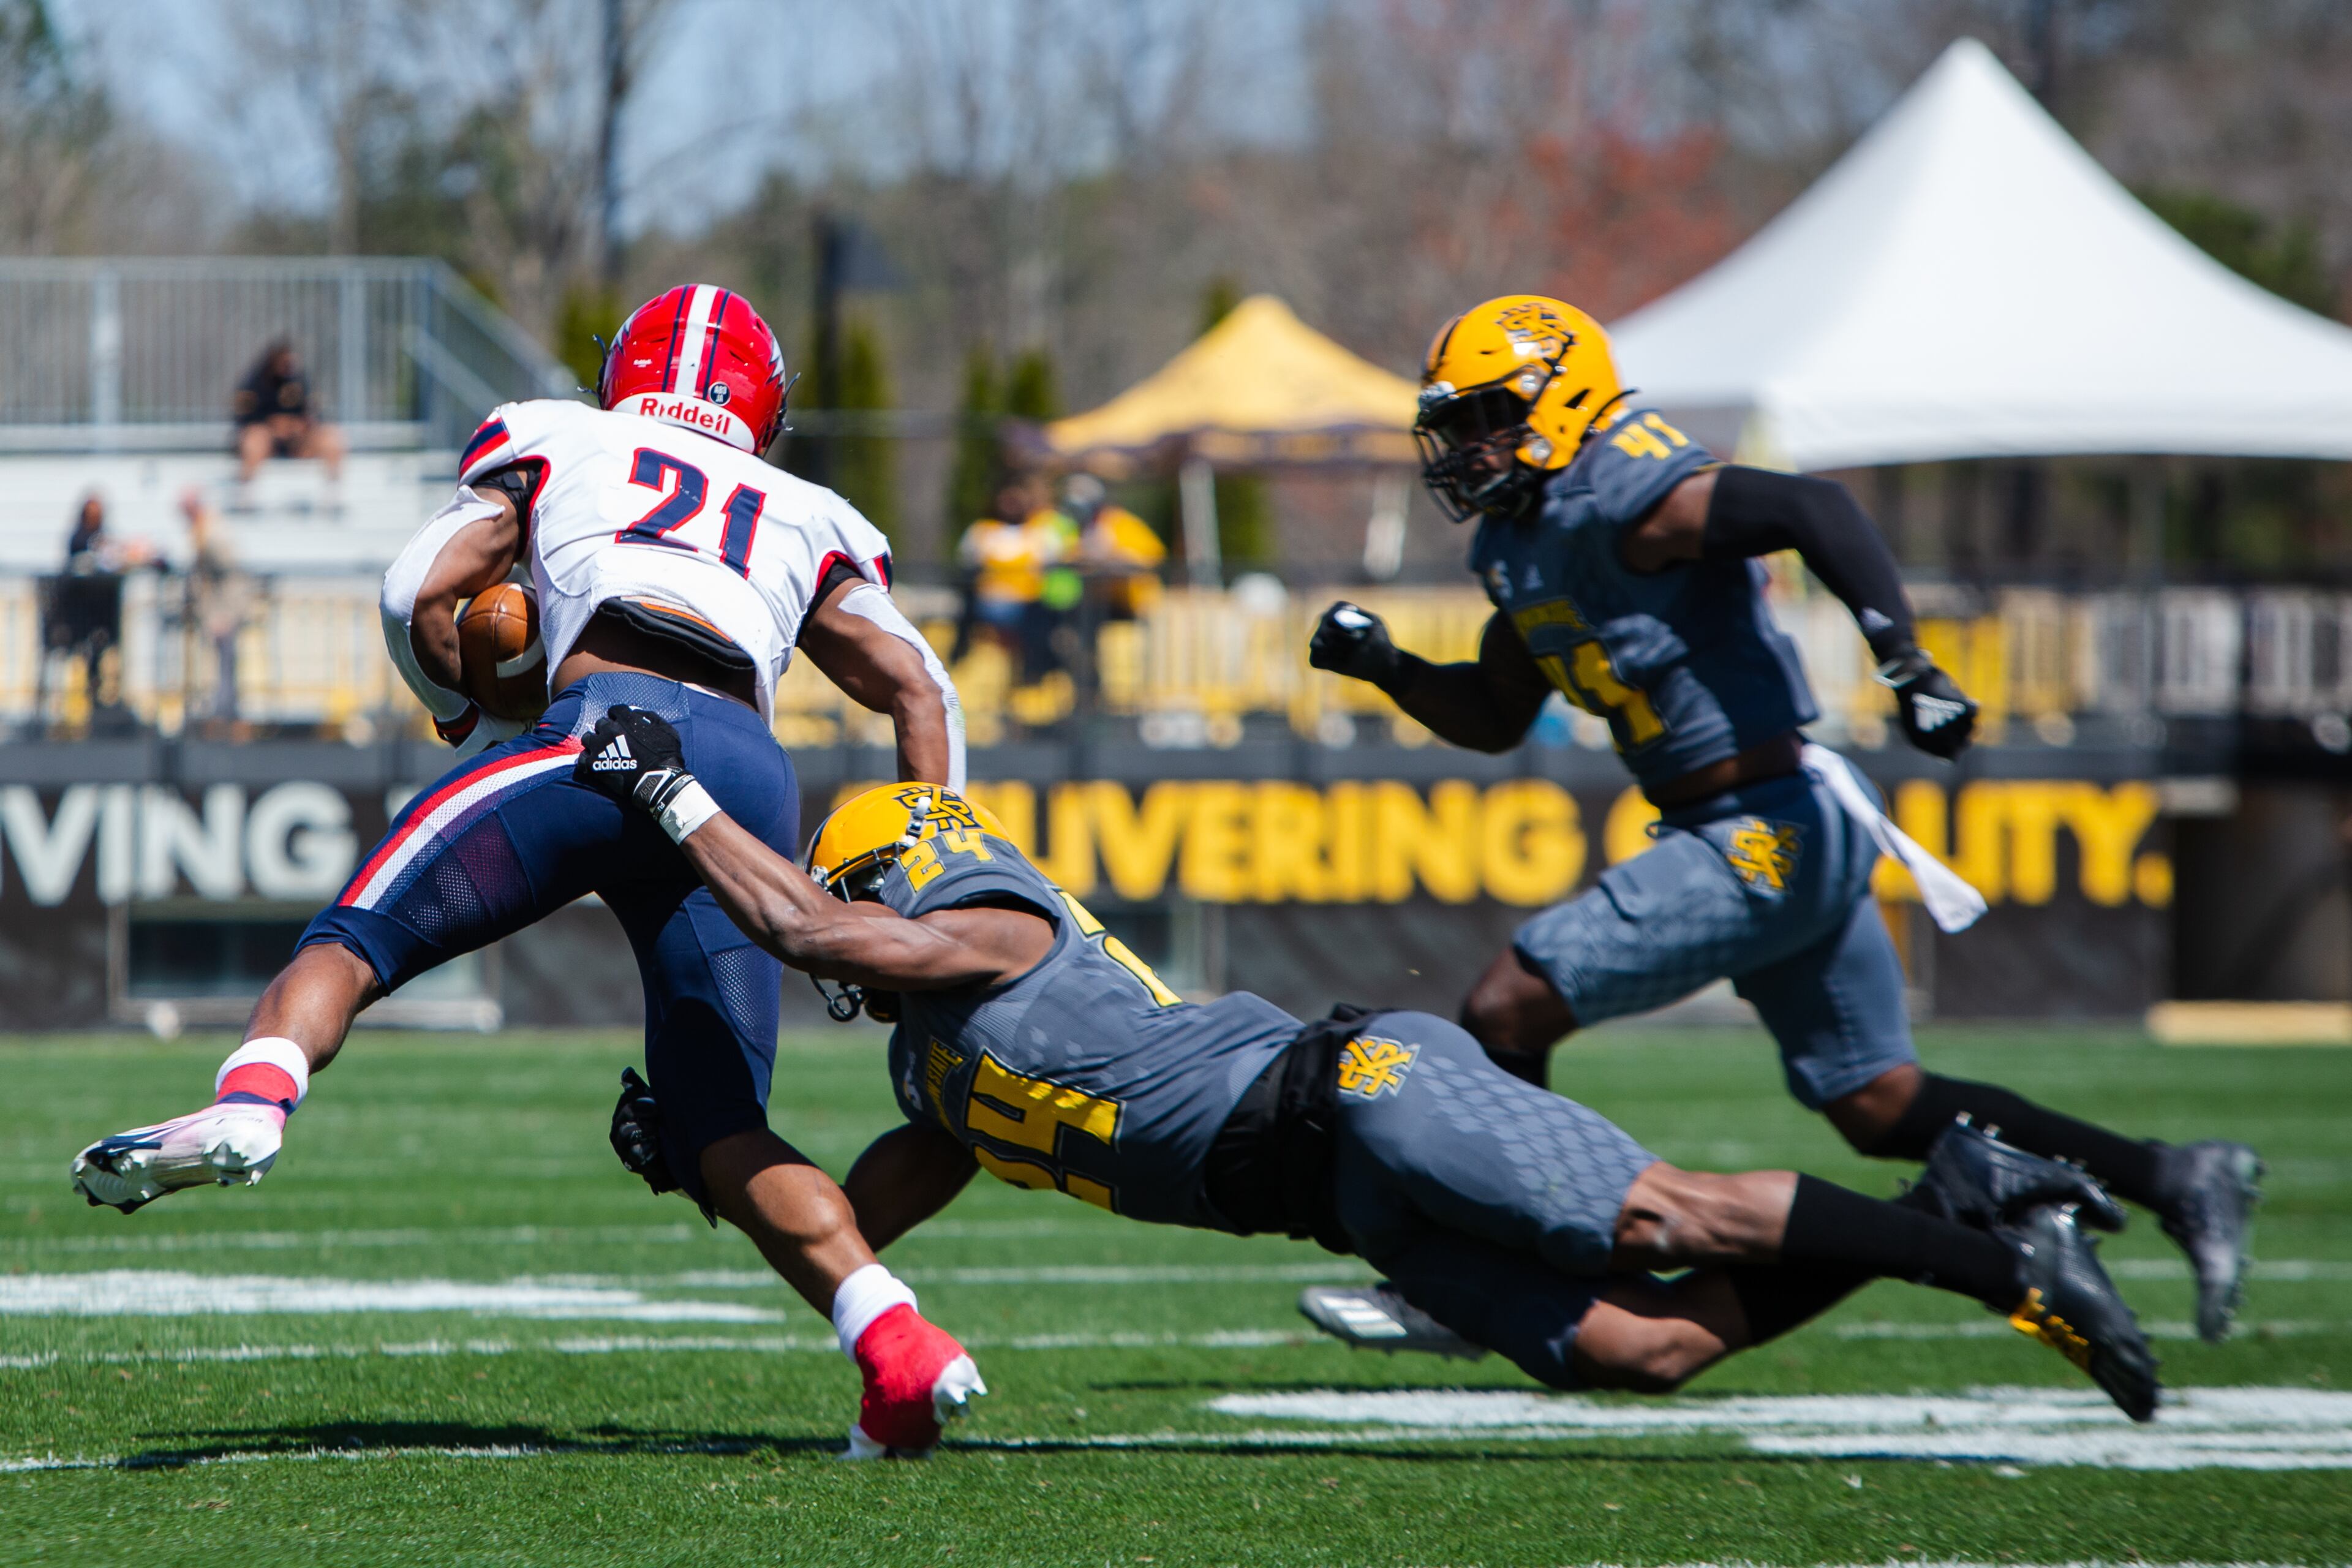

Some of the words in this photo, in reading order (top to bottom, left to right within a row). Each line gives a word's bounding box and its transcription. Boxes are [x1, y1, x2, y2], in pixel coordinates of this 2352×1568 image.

[614, 447, 766, 580] 21
[592, 758, 638, 771] adidas
[0, 780, 360, 905] VING
[834, 778, 1588, 905] LIVERING
[1603, 778, 2174, 908] LITY.
[899, 831, 995, 894] 24
